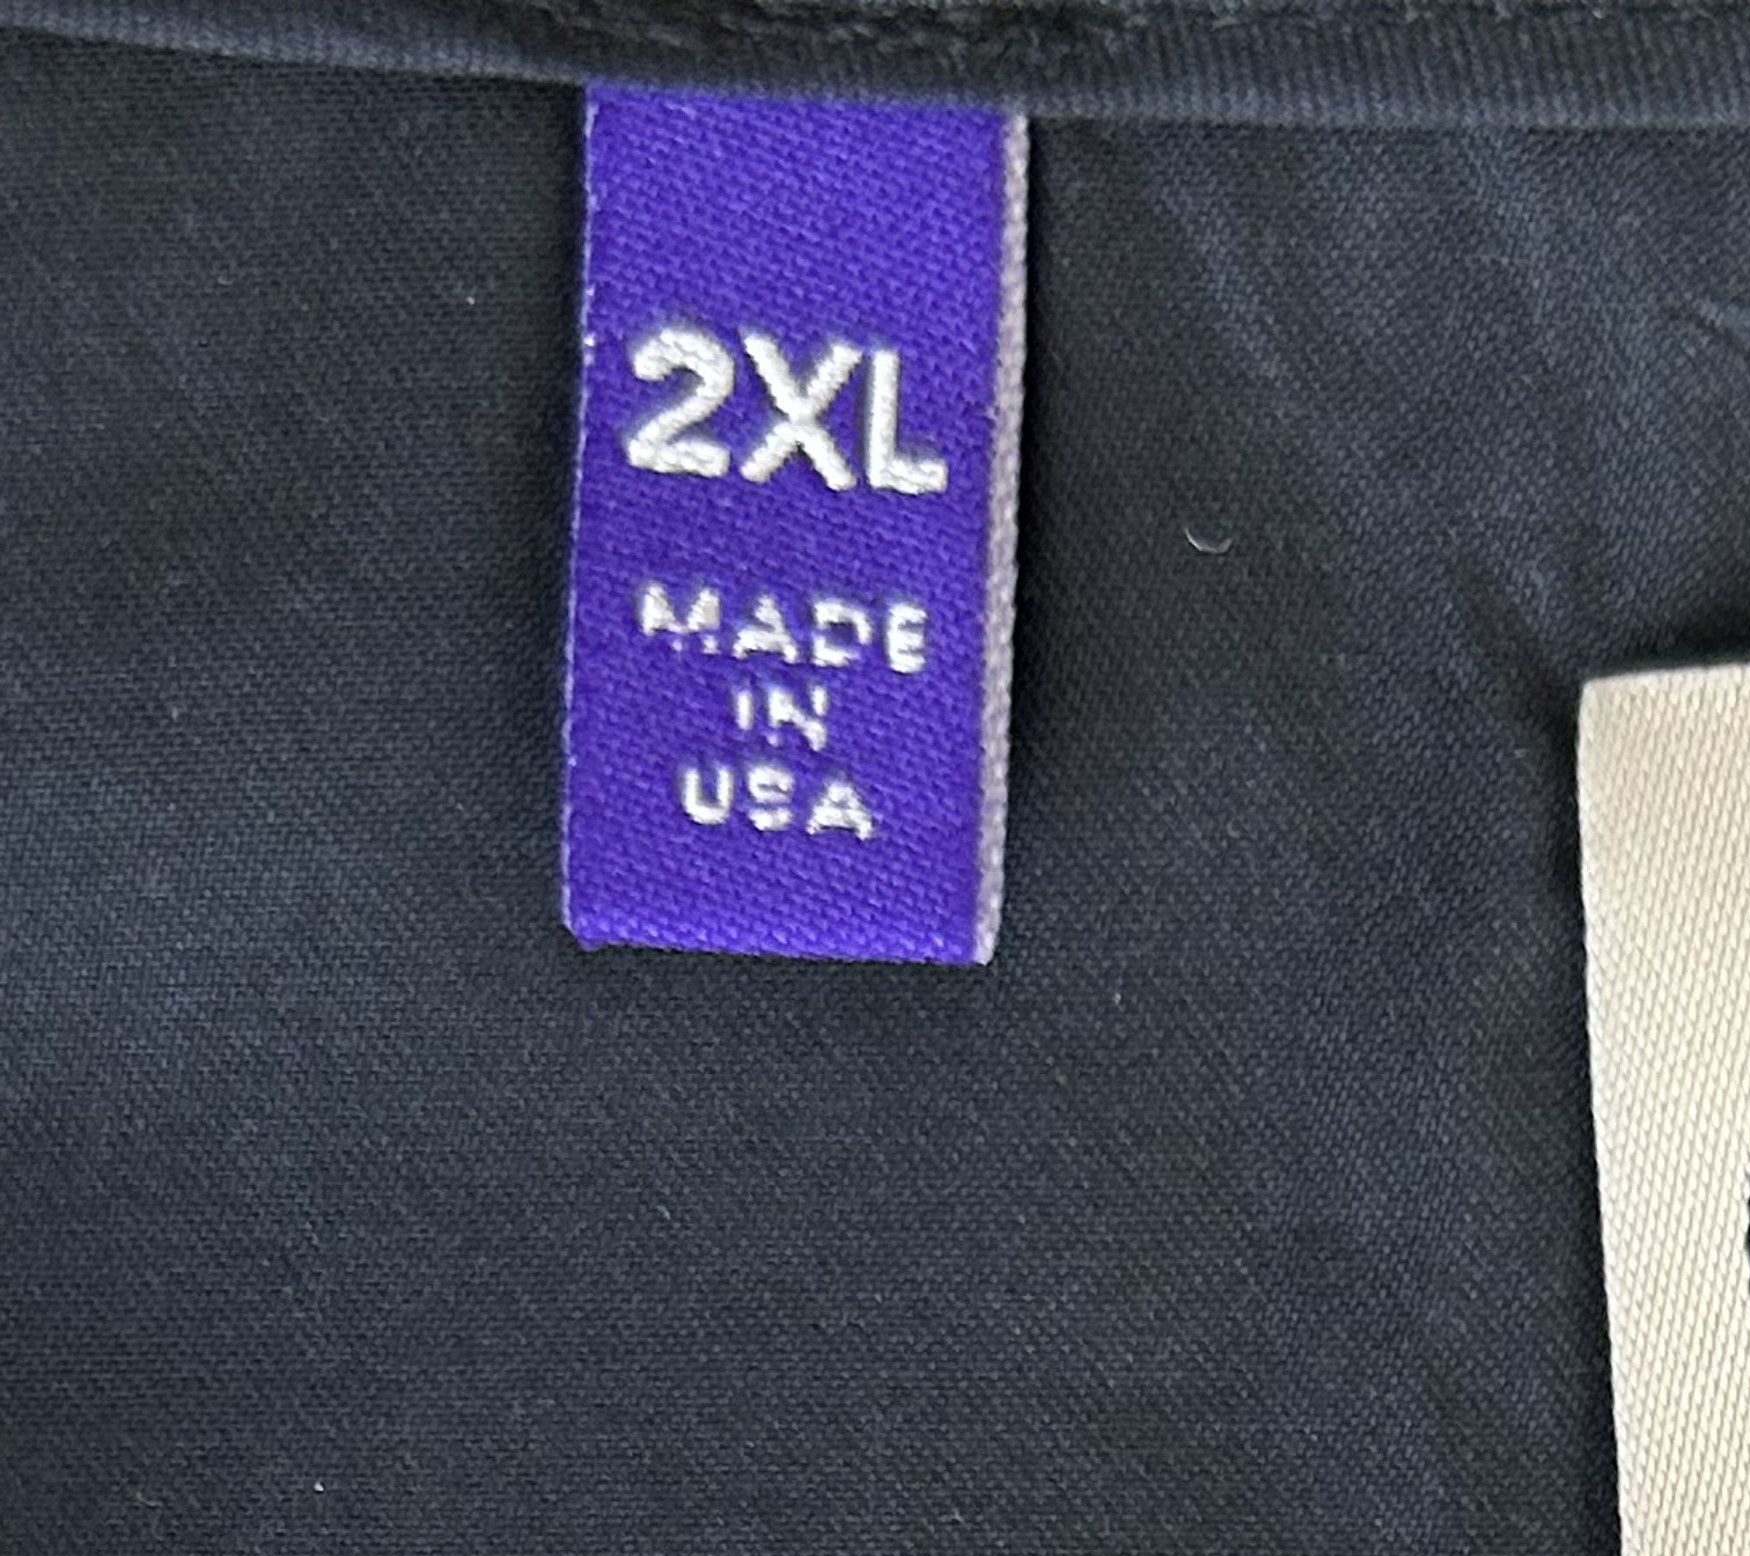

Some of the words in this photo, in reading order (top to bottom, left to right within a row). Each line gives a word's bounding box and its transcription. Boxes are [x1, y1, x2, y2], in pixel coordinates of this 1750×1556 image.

[624, 322, 949, 495] 2XL
[638, 580, 928, 674] MADE
[732, 683, 829, 752] IN
[681, 761, 878, 841] USA
